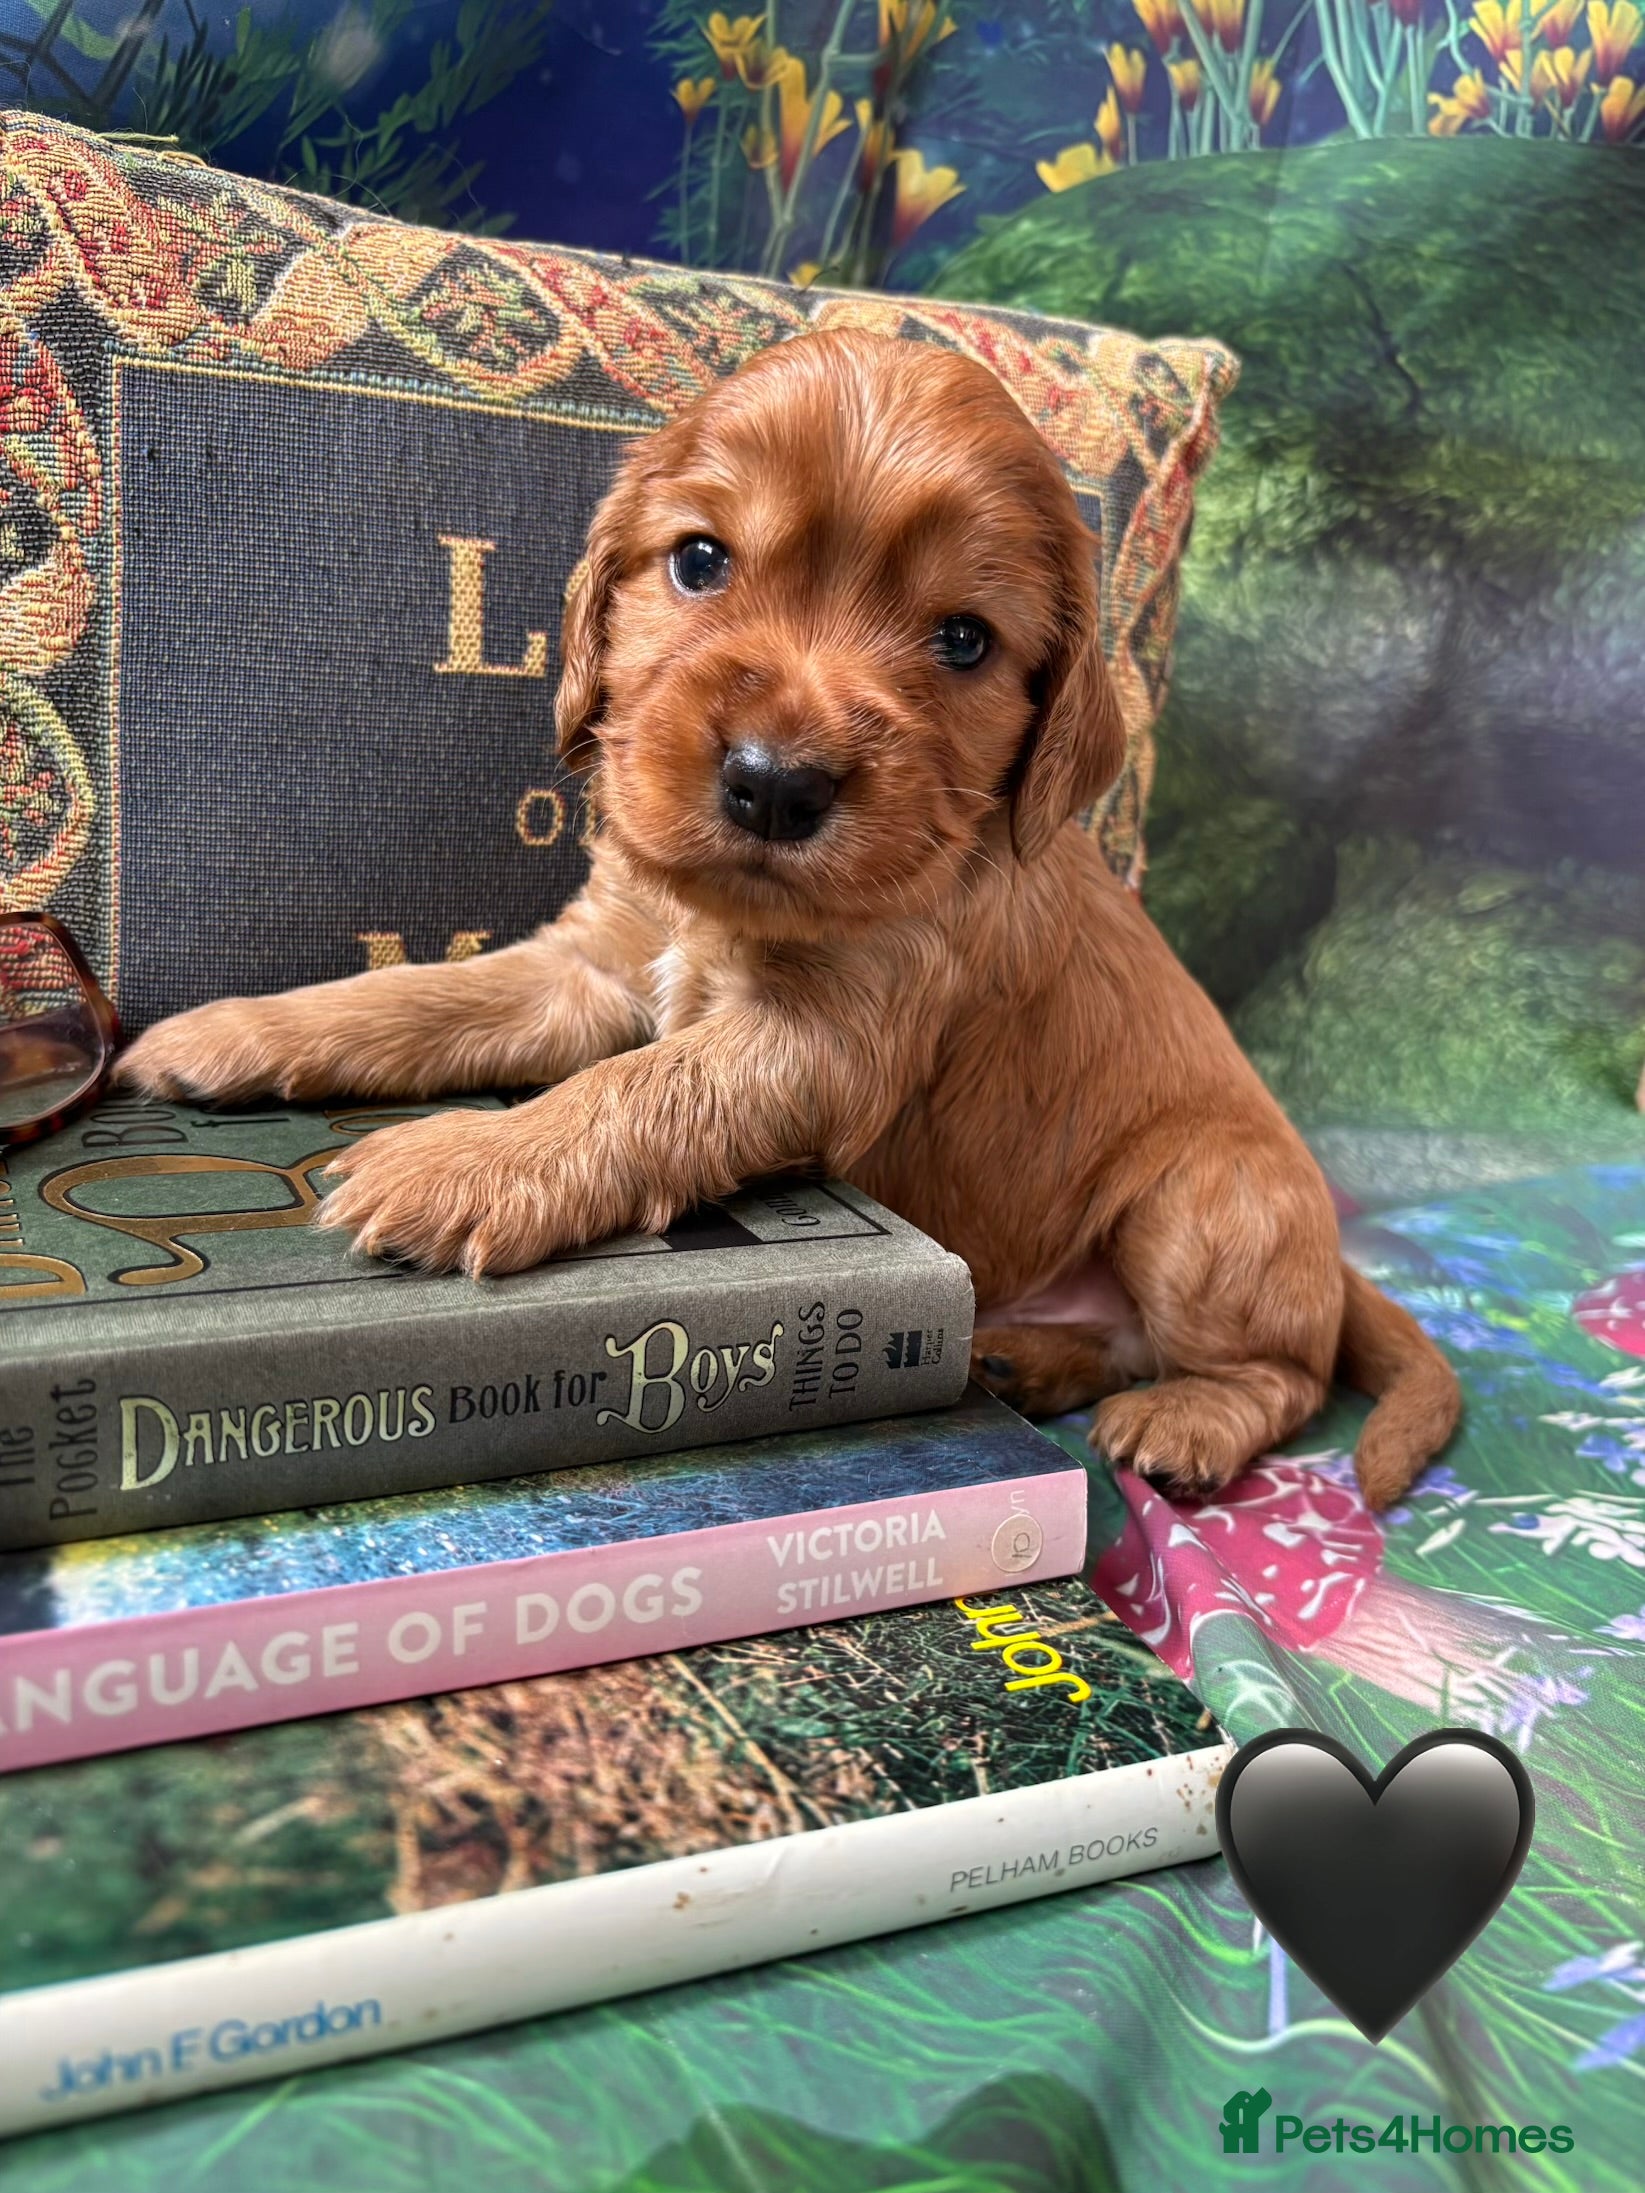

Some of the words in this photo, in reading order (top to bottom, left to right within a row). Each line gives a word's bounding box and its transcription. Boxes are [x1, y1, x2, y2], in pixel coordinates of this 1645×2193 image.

[789, 1301, 825, 1411] THINGS
[835, 1308, 864, 1354] DO
[931, 1328, 944, 1365] Collins
[118, 1384, 438, 1492] DANGEROUS
[448, 1373, 542, 1425] Book
[552, 1369, 607, 1408] for
[596, 1318, 784, 1435] Boys
[829, 1362, 859, 1399] TO
[49, 1378, 98, 1521] Pocket
[766, 1509, 946, 1568] VICTORIA
[776, 1556, 944, 1616] STILWELL
[0, 1622, 360, 1737] NGUAGE
[387, 1601, 488, 1664] OF
[515, 1565, 702, 1646] DOGS
[950, 1849, 1060, 1892] PELHAM
[1068, 1826, 1159, 1866] BOOKS
[40, 2047, 163, 2102] John
[169, 2027, 205, 2071] F
[208, 1998, 383, 2063] Gordon
